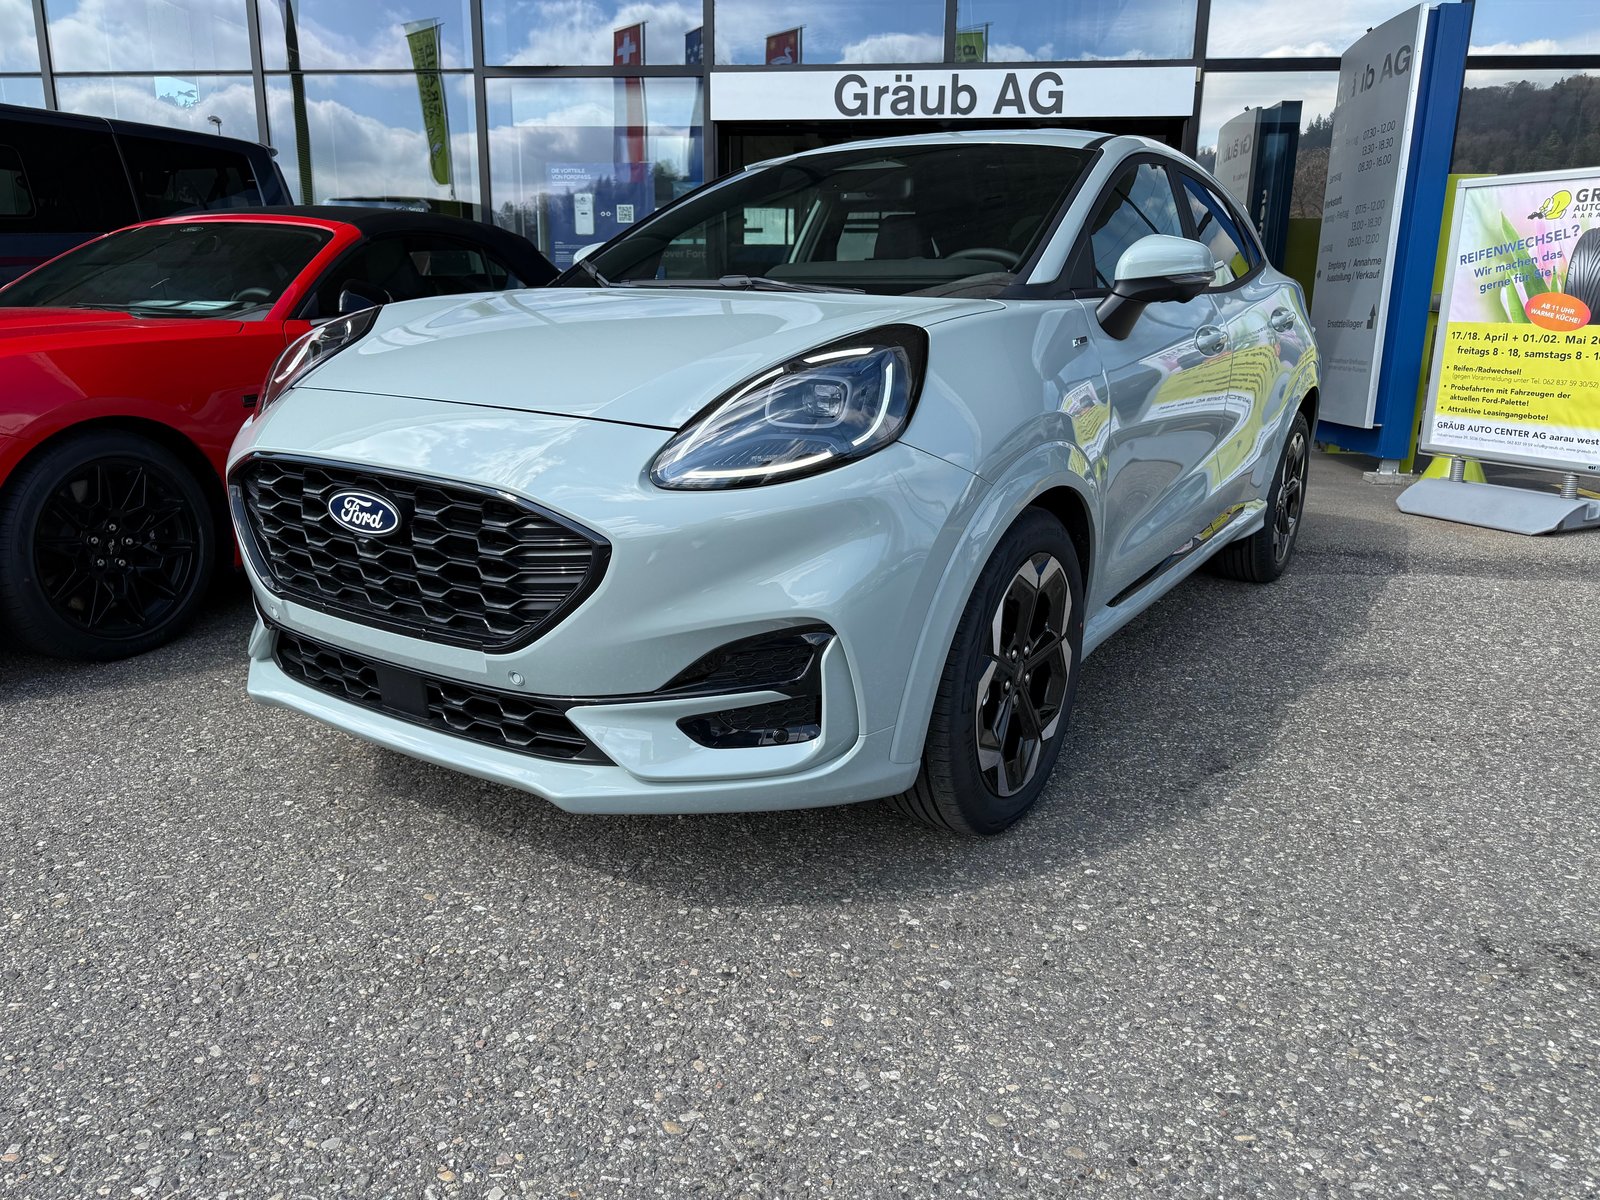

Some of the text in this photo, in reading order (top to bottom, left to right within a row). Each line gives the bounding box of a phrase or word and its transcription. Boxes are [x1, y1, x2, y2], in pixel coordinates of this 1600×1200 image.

[1379, 45, 1412, 83] AG
[834, 71, 1064, 117] Gräub AG
[1460, 224, 1580, 265] REIFENWECHSEL?
[1474, 250, 1563, 278] Wir machen das
[1356, 269, 1380, 280] Verkauf
[1480, 266, 1556, 294] gerne für Sie!
[1531, 308, 1581, 324] WARME KÜCHE!
[1452, 332, 1480, 341] 17./18.
[1484, 333, 1508, 343] April
[1523, 334, 1560, 343] 01./02.
[1565, 335, 1587, 344] Mai
[1457, 346, 1490, 357] freitags
[1493, 348, 1498, 356] 8
[1508, 349, 1520, 358] 18,
[1525, 351, 1572, 361] samstags
[1576, 351, 1582, 360] 8
[1450, 384, 1494, 393] Probefahrten
[1510, 388, 1554, 399] Fahrzeugen
[1450, 394, 1529, 406] aktuellen Ford-Palette!
[1447, 405, 1548, 420] Attraktive Leasingangebote!
[1437, 421, 1465, 431] GRÄUB
[1467, 425, 1492, 433] AUTO
[1494, 427, 1529, 438] CENTER
[1532, 432, 1546, 440] AG
[1577, 437, 1599, 445] west
[341, 496, 384, 529] Ford
